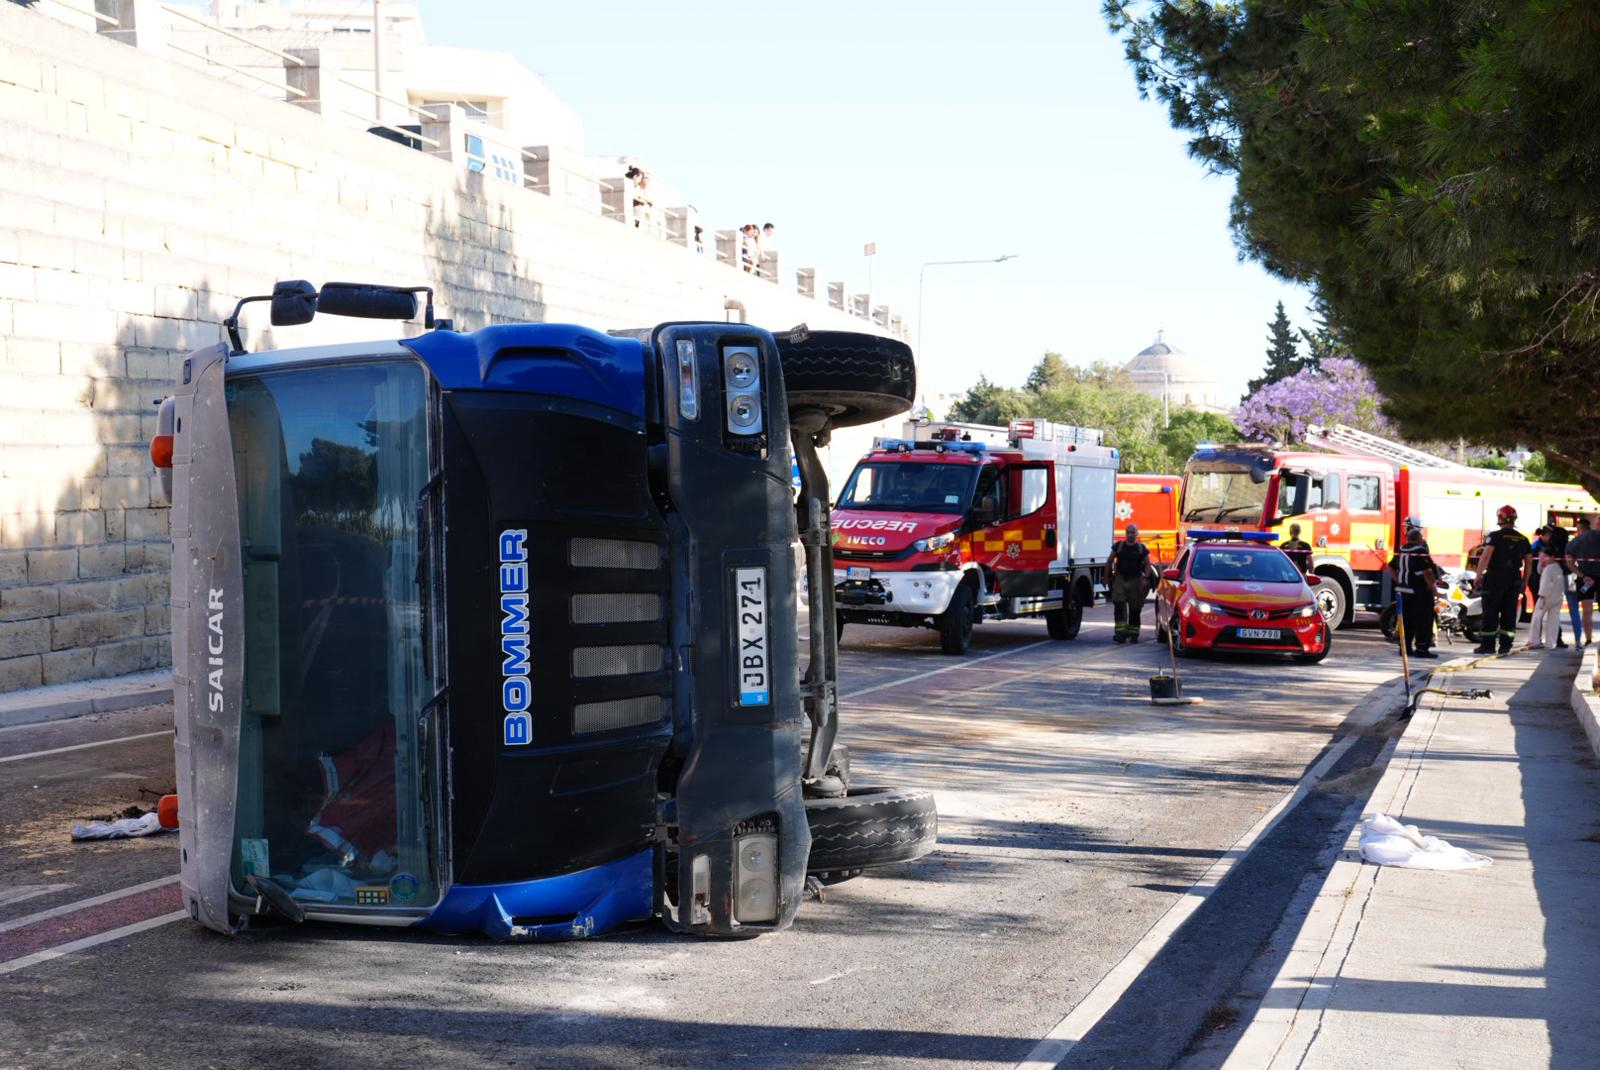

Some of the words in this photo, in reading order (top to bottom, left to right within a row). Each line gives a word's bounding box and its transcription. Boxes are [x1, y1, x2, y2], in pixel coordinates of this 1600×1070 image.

[847, 535, 886, 545] IVECO
[741, 577, 762, 625] 271
[208, 588, 224, 713] SAICAR
[500, 529, 532, 745] BOMMER
[742, 637, 765, 687] JBX
